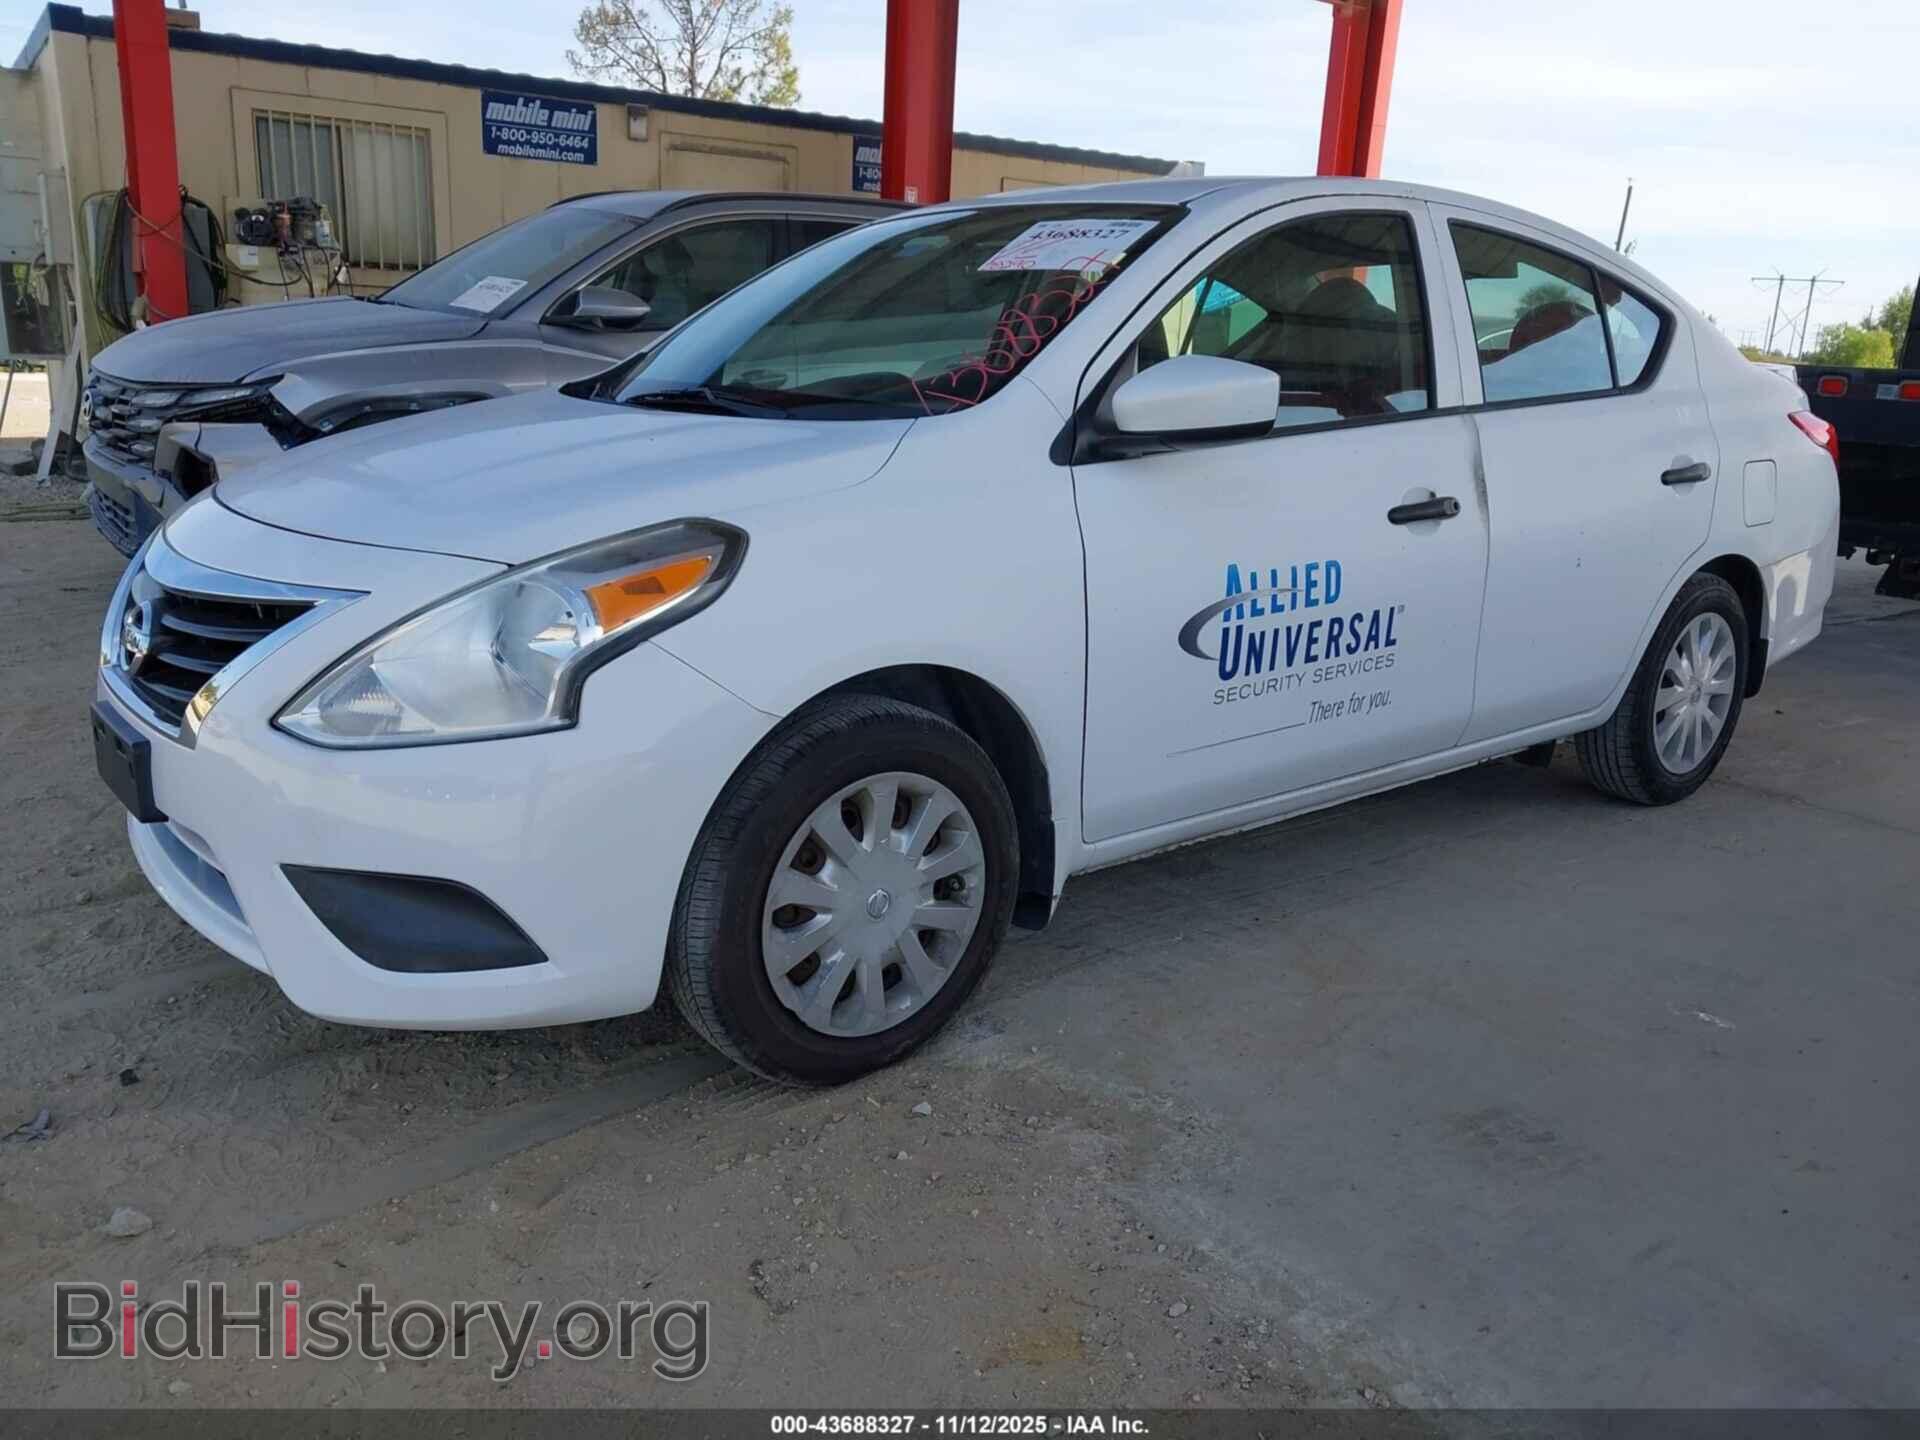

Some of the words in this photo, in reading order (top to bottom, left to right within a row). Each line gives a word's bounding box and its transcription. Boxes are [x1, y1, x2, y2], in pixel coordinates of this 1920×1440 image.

[486, 97, 549, 126] mobile
[551, 108, 593, 131] mini
[490, 126, 589, 149] 1-800-950-6464
[497, 143, 585, 162] mobilemini.com
[1222, 560, 1342, 622] ALLIED
[1218, 605, 1398, 681] UNIVERSAL
[1213, 671, 1306, 705] SECURITY
[1312, 653, 1395, 684] SERVICES
[1308, 700, 1345, 724] There
[1347, 690, 1365, 716] for
[1366, 688, 1392, 716] you.
